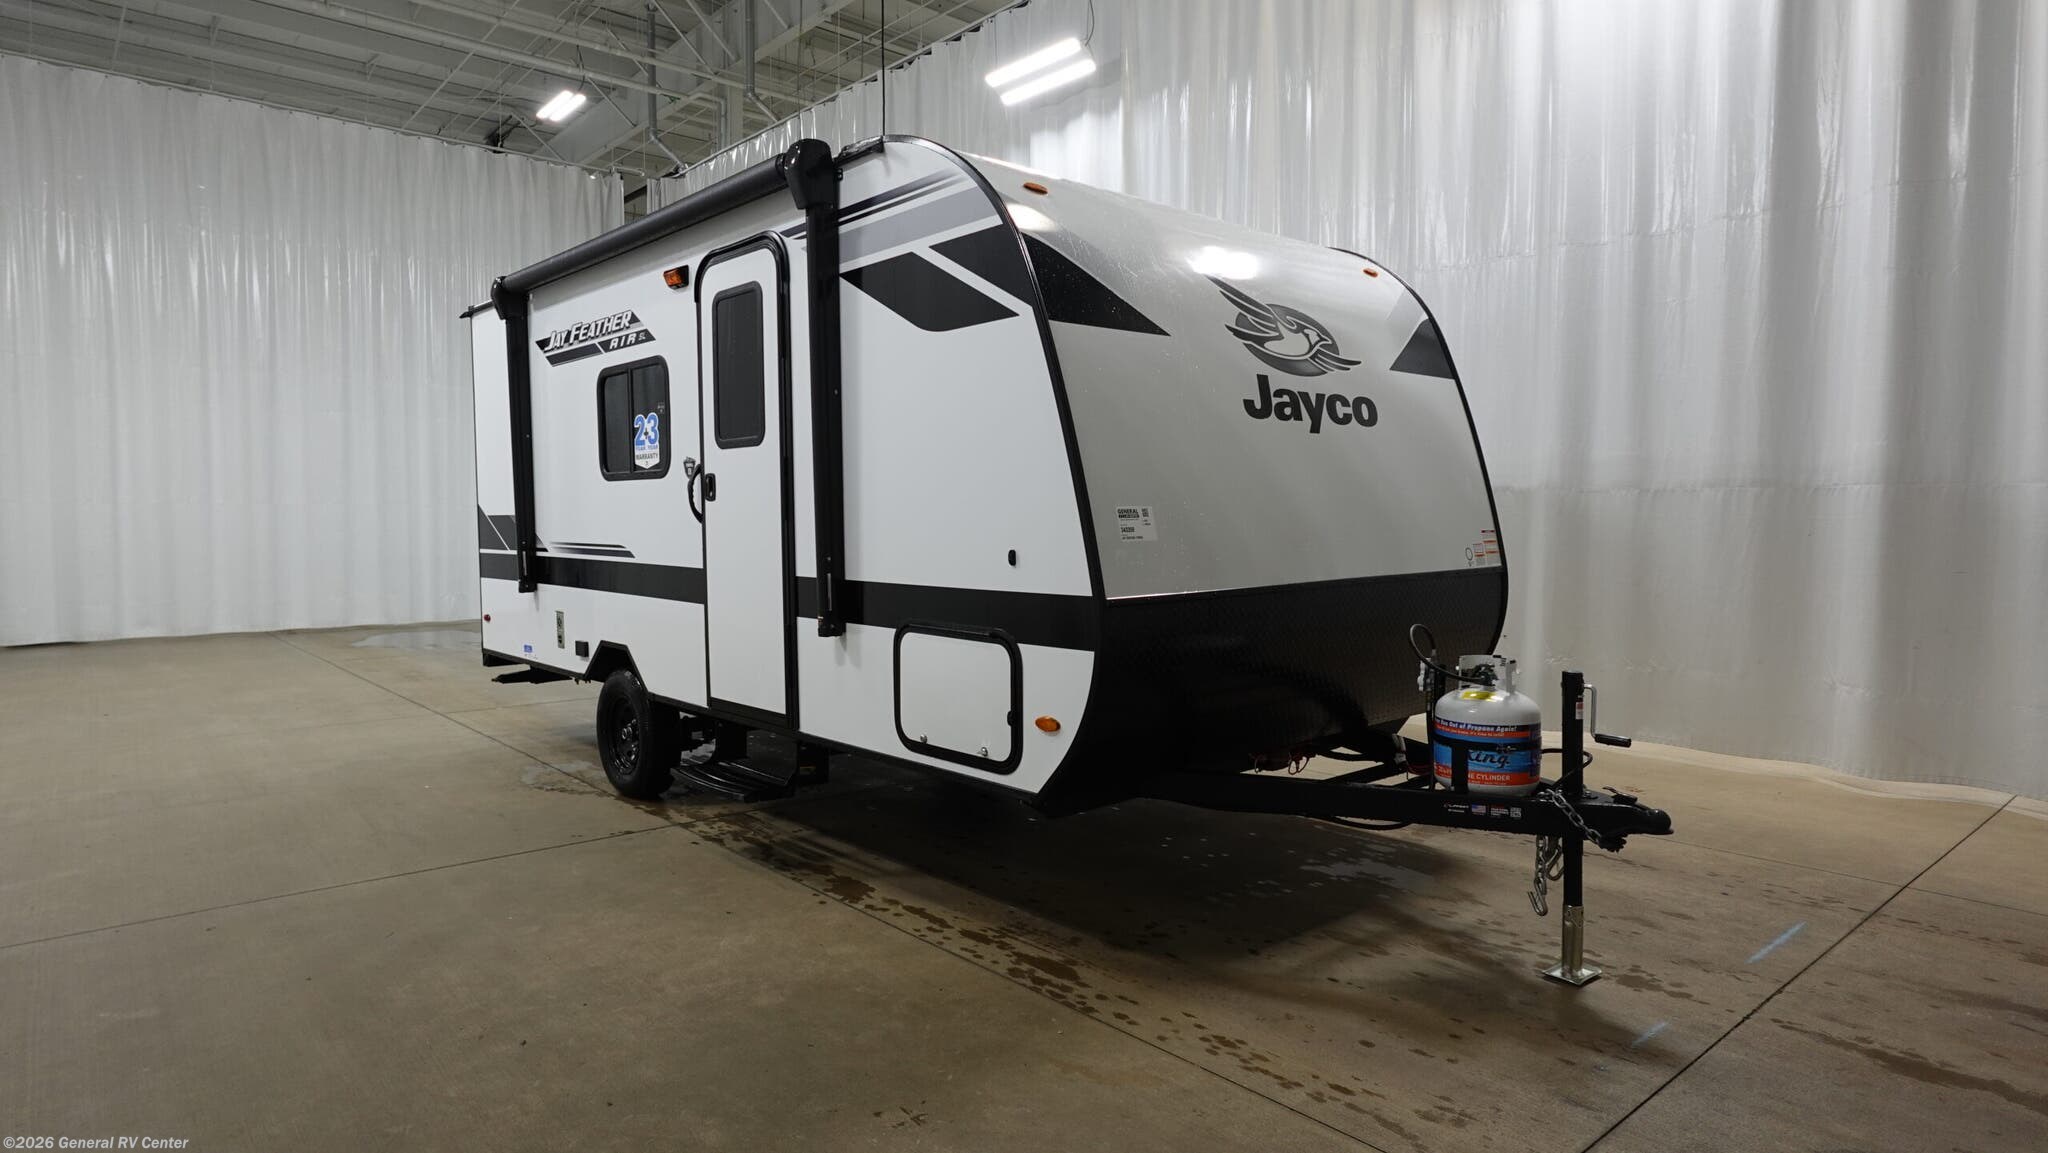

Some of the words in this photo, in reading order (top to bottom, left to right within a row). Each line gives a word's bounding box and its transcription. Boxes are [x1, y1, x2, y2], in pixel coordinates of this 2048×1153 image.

[544, 330, 569, 351] JAY
[569, 310, 632, 344] FEATHER
[609, 333, 637, 350] AIR
[1243, 374, 1378, 434] Jayco
[1449, 721, 1459, 729] Out
[1467, 723, 1495, 732] Propane
[1476, 773, 1511, 781] CYLINDER
